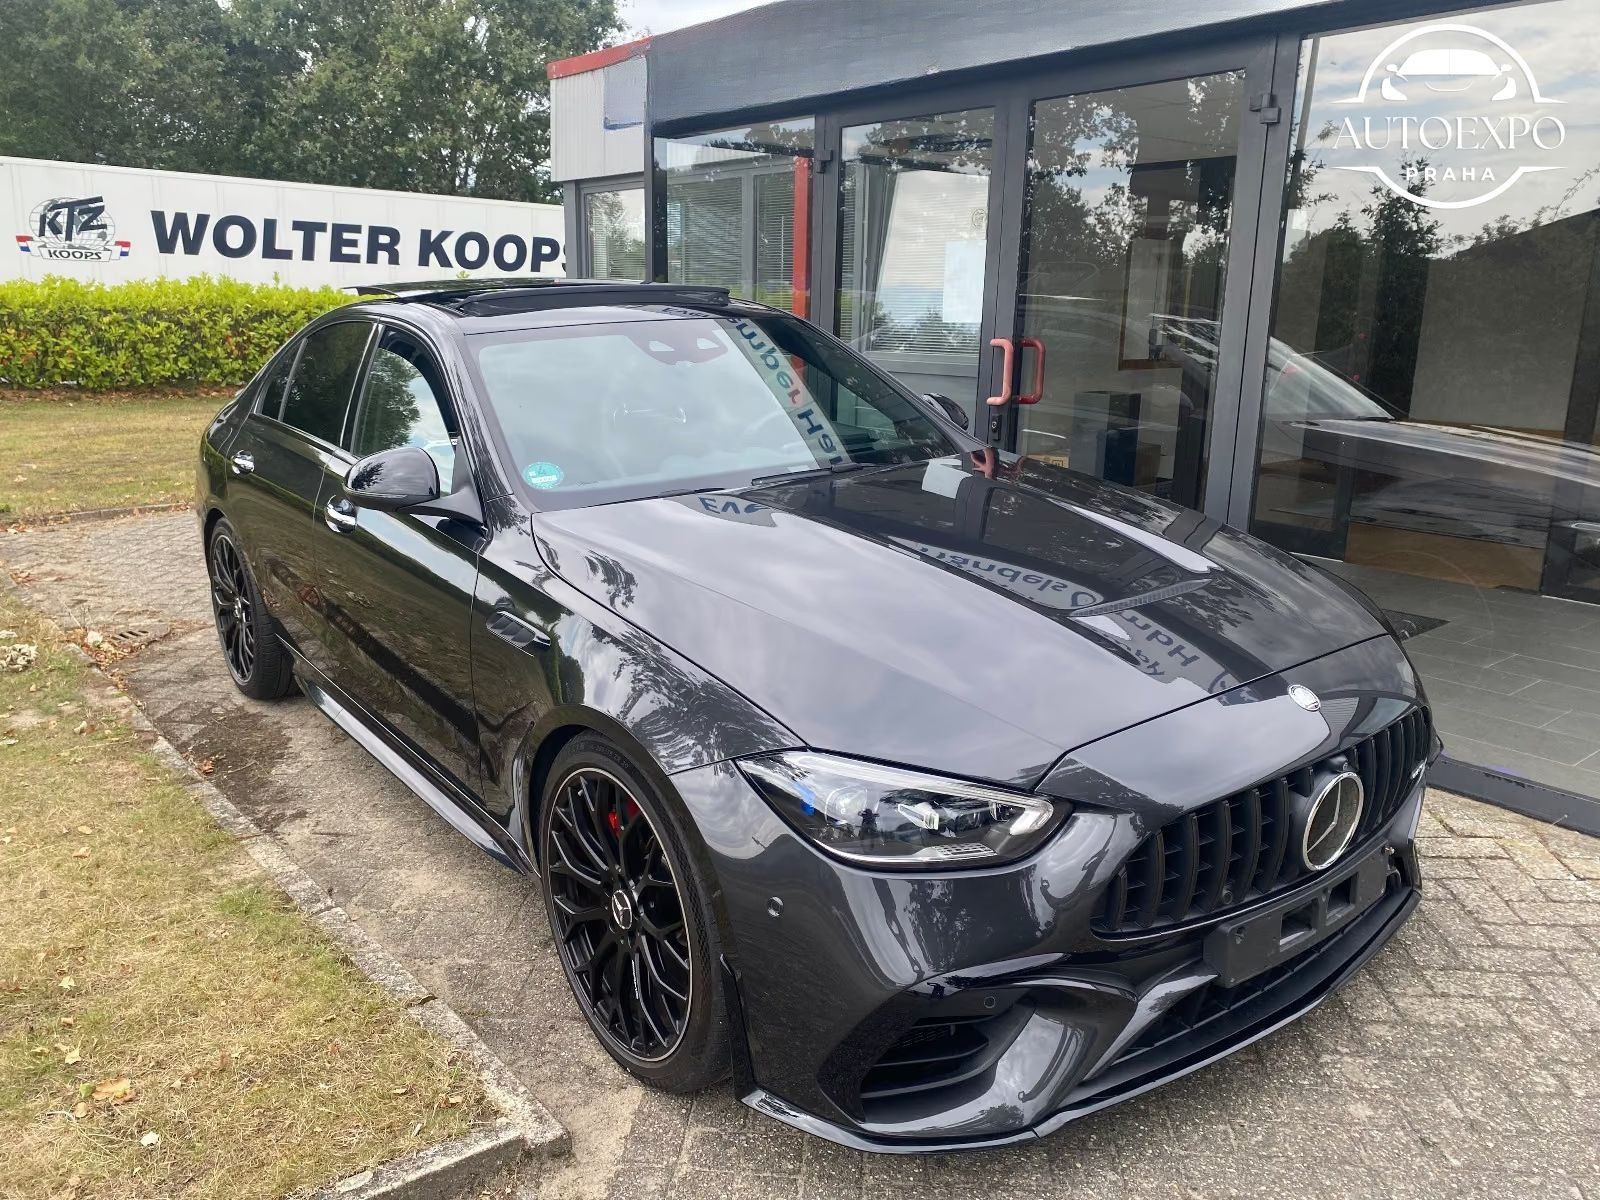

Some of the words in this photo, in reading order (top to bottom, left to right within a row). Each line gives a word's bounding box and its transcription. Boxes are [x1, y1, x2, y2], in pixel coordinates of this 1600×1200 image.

[38, 196, 107, 242] KTZ
[150, 210, 401, 266] WOLTER
[418, 229, 566, 273] KOOP
[48, 249, 102, 260] KOOPS
